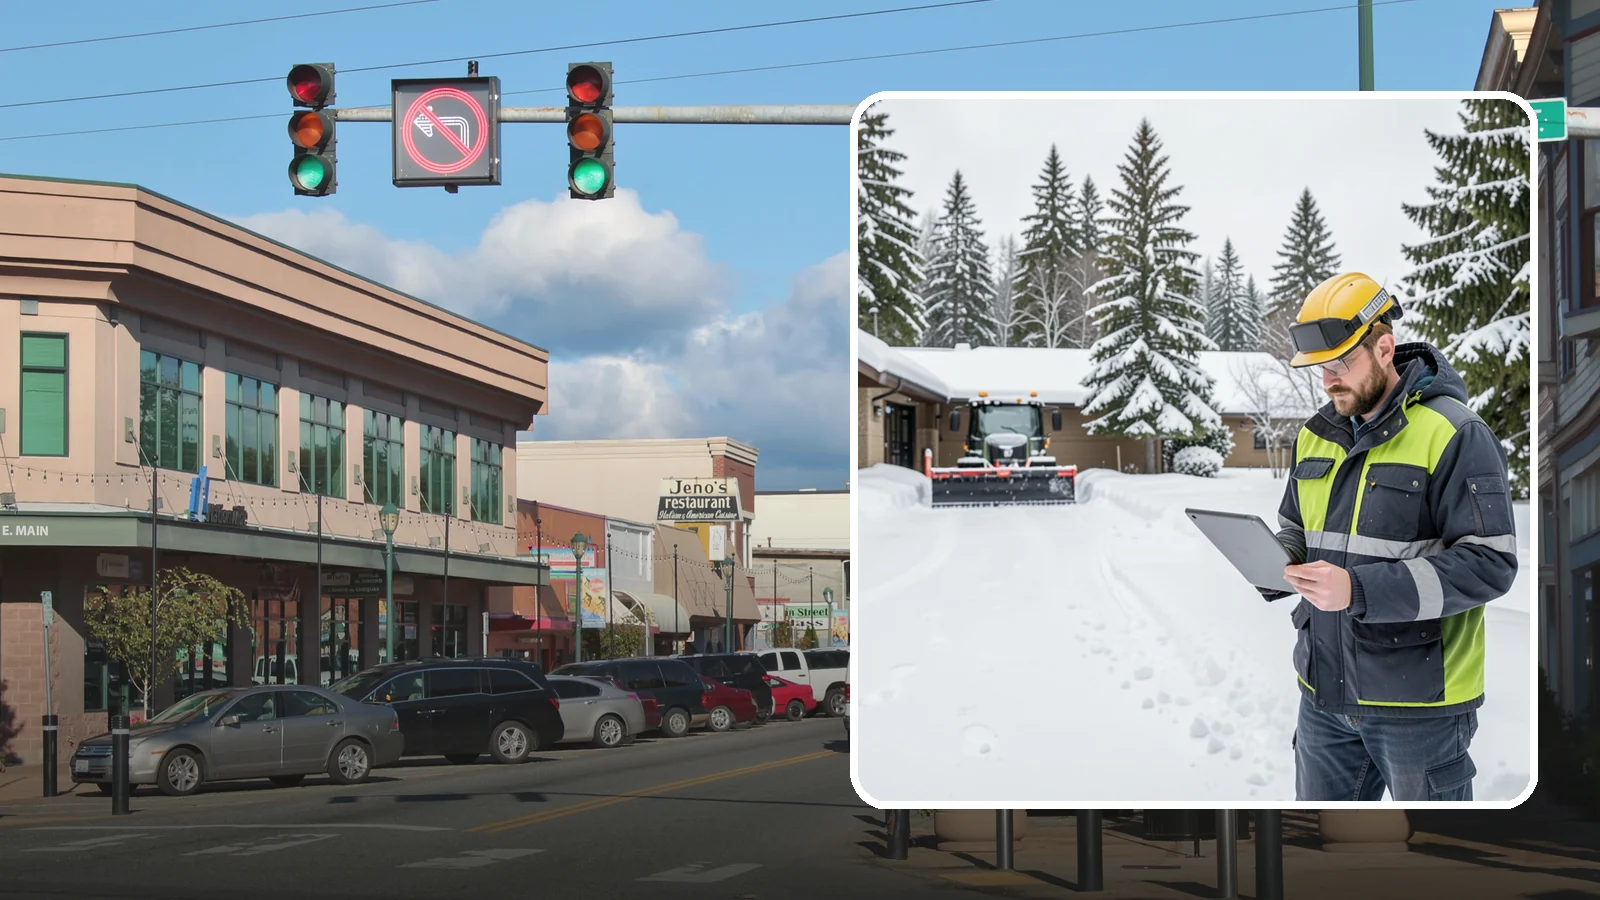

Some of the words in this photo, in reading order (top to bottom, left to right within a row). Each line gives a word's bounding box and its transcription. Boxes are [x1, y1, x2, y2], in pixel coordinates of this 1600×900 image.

[670, 480, 727, 494] Jeno's
[665, 496, 730, 509] restaurant
[659, 510, 682, 520] Italian
[686, 510, 714, 519] American
[715, 509, 737, 519] Cuisine
[2, 525, 13, 536] E.
[15, 525, 49, 536] MAIN
[797, 607, 828, 616] Street
[790, 619, 824, 627] lass
